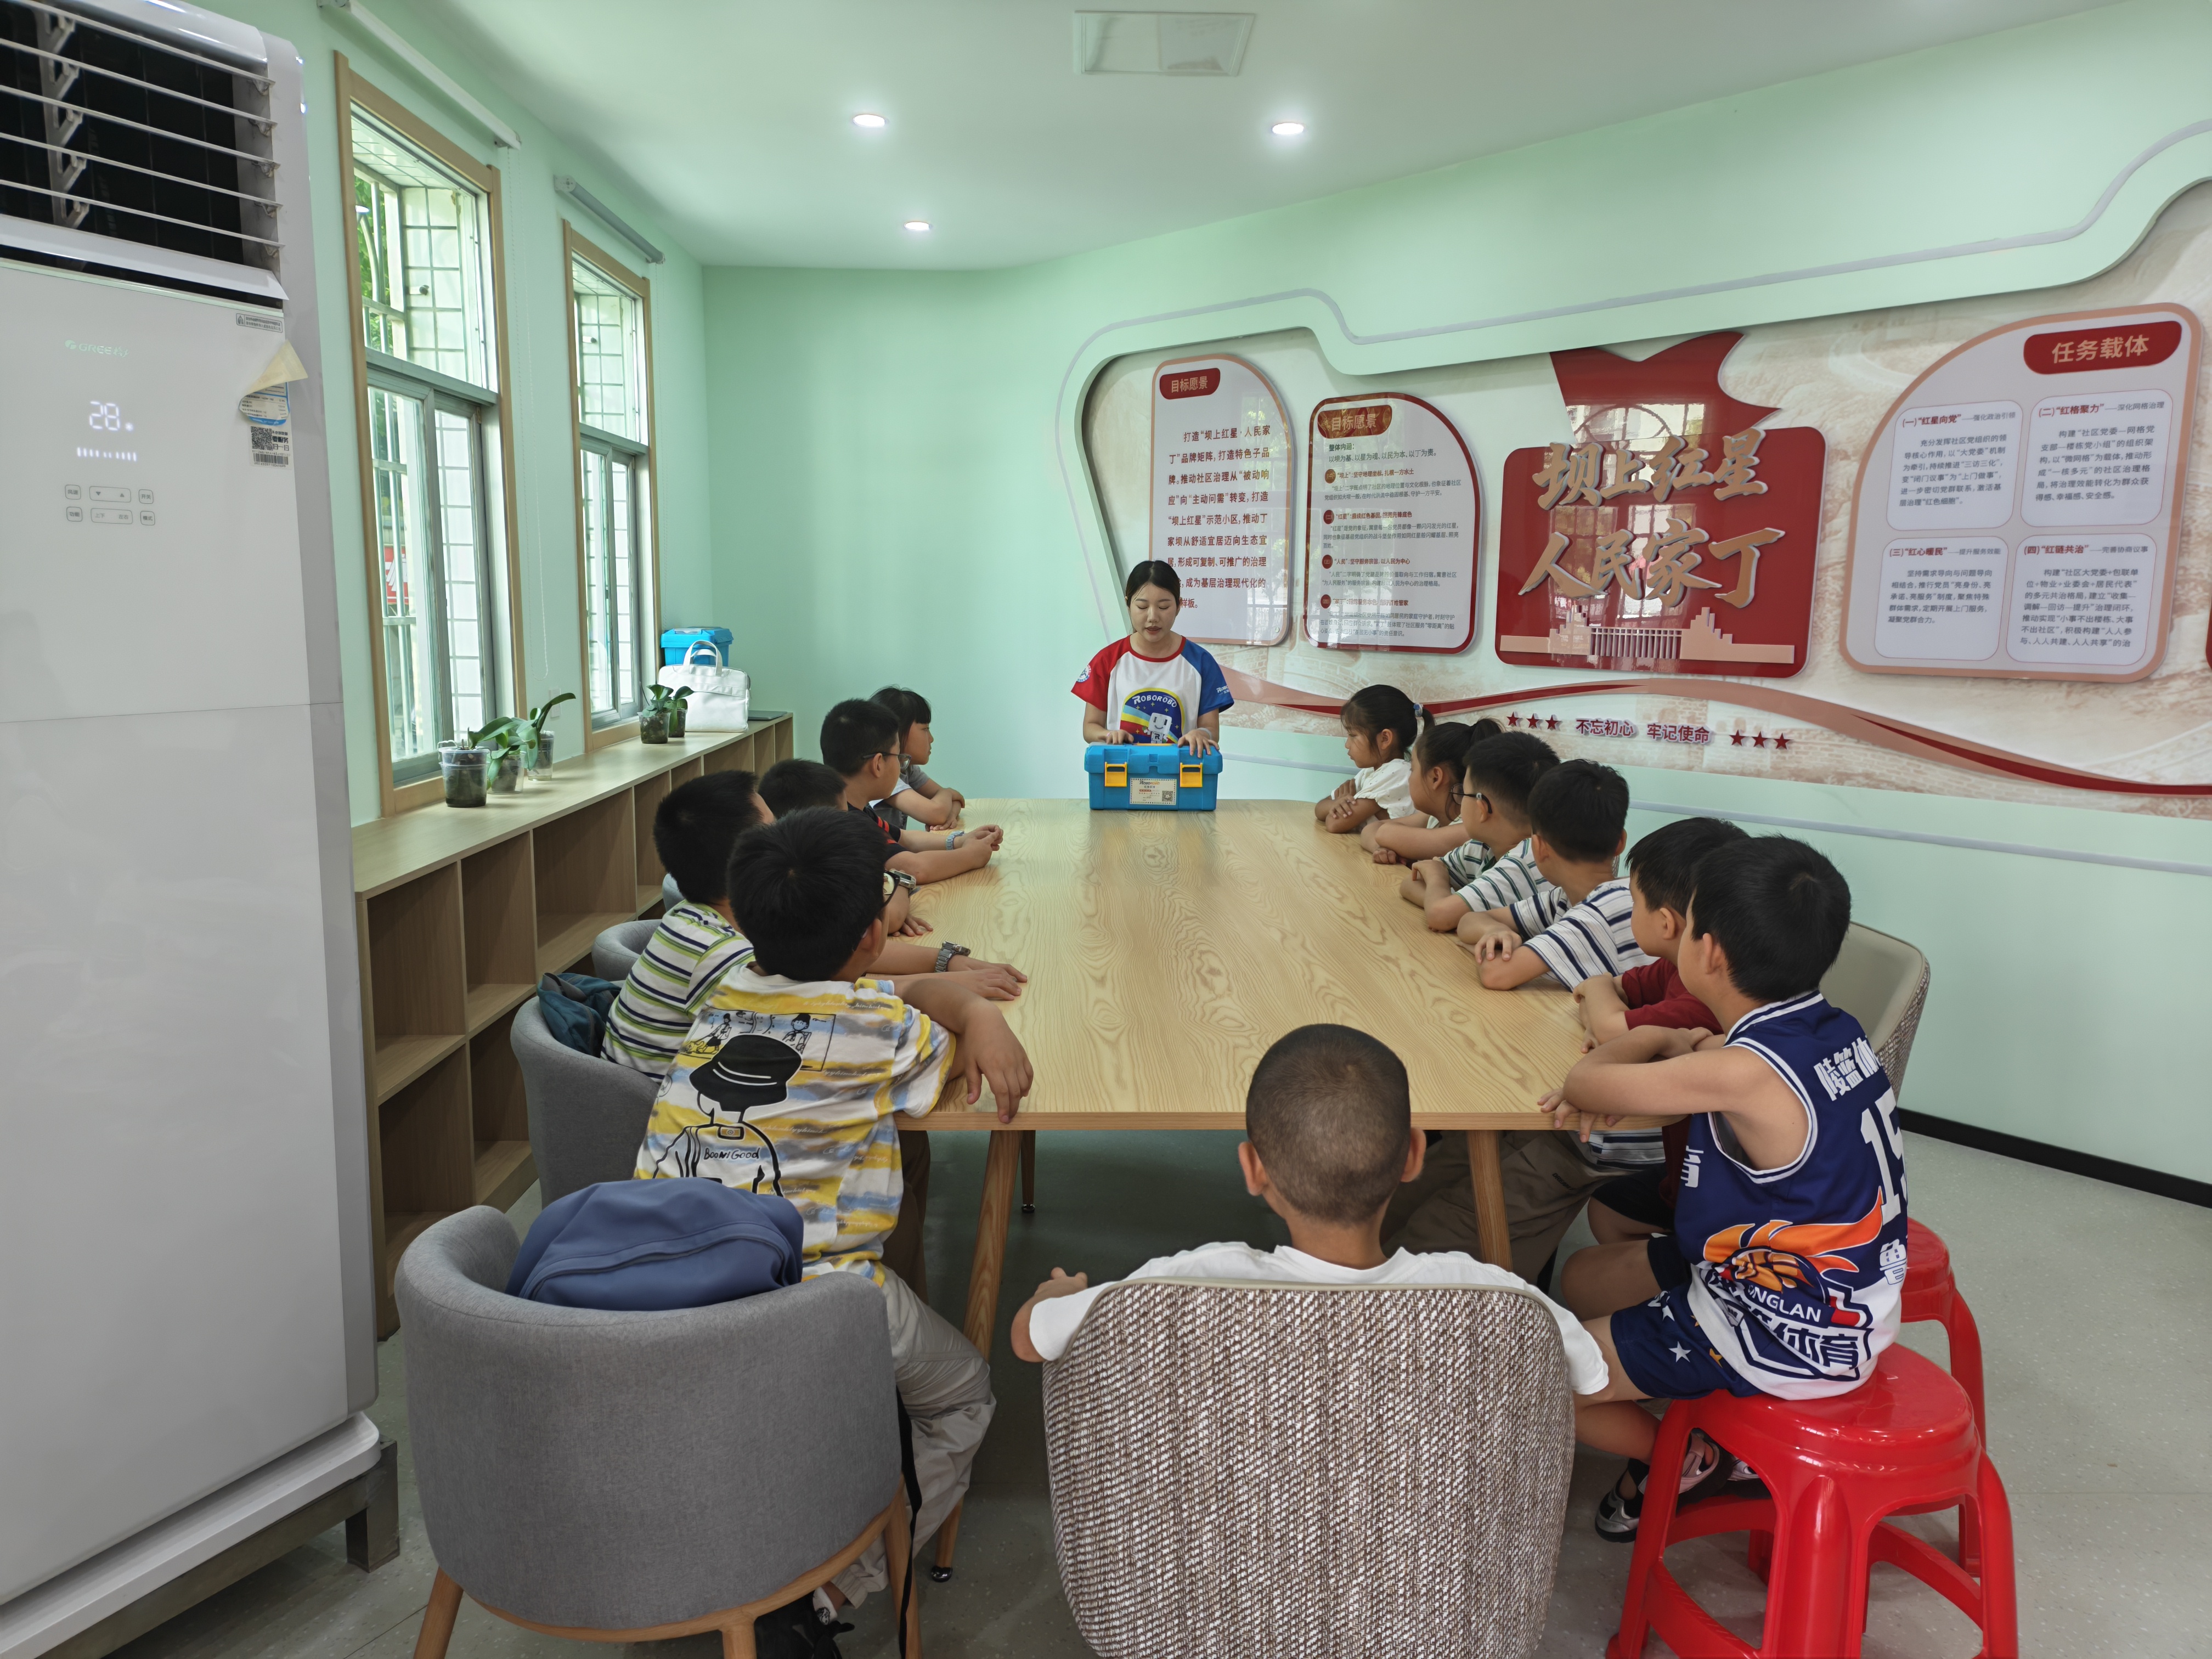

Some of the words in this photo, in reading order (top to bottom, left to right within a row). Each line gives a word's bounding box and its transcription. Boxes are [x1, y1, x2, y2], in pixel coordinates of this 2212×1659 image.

[78, 343, 112, 354] GREE
[2052, 335, 2149, 364] 任务载体
[1171, 376, 1208, 393] 目标愿景
[89, 400, 121, 431] 28
[1331, 413, 1377, 431] 目标愿景
[1920, 434, 2007, 447] 充分发挥社区党组织的领
[1532, 427, 1769, 511] 坝上红星
[1167, 535, 1267, 546] 家坝从舒适宜居迈向生态宜
[1518, 518, 1786, 608] 人民家丁
[1576, 719, 1634, 737] 不忘初心
[1647, 724, 1711, 744] 牢记使命
